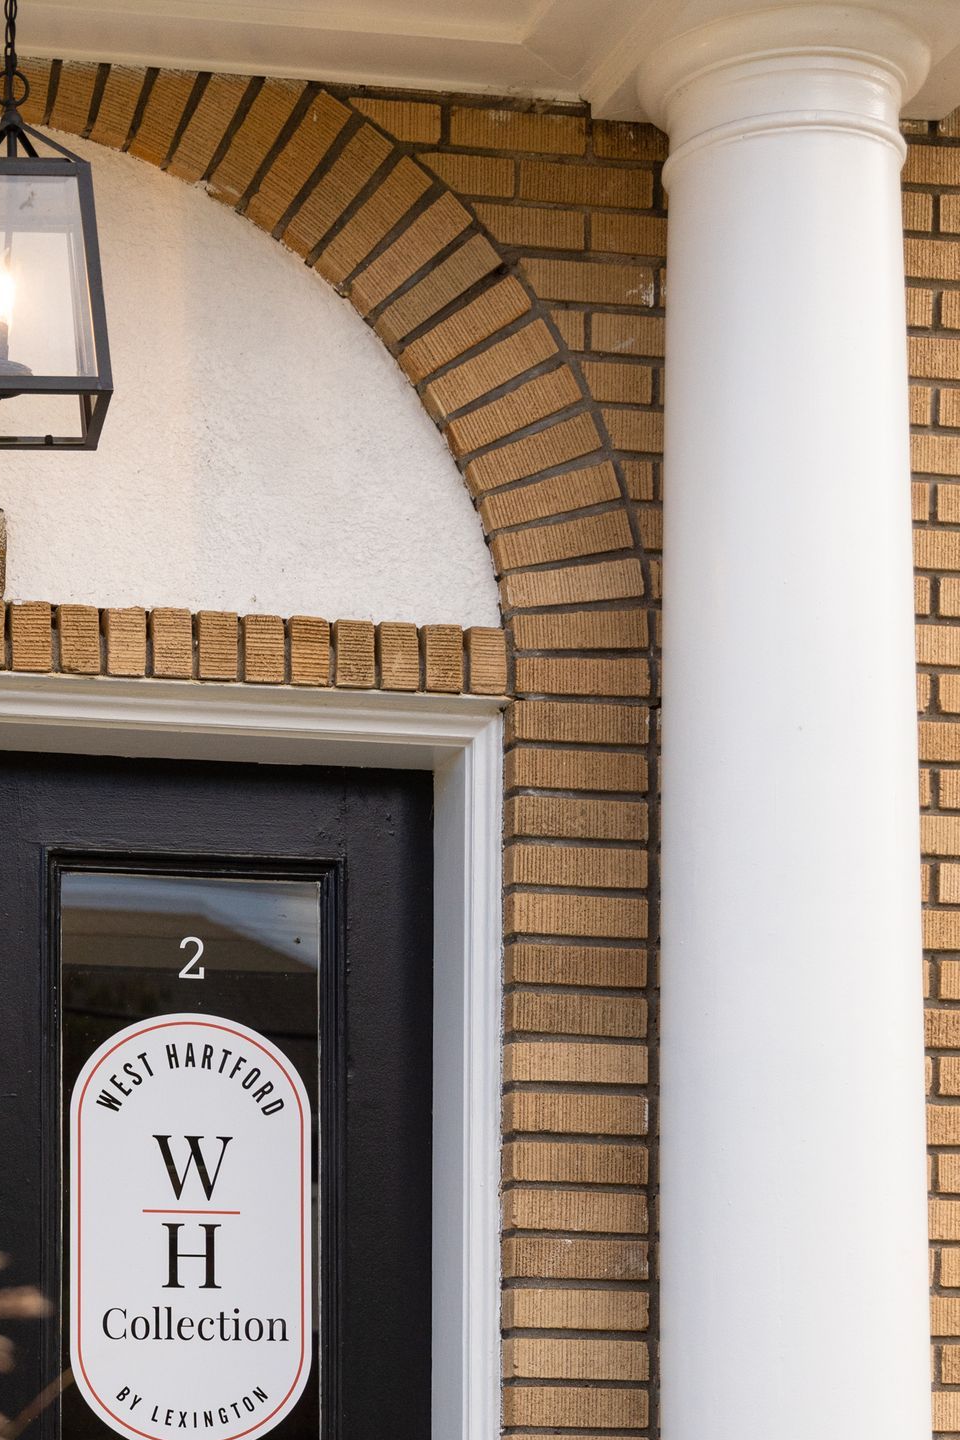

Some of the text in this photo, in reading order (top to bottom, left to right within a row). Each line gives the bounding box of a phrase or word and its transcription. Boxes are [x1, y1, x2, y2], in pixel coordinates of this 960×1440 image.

[178, 936, 205, 980] 2
[95, 1042, 285, 1116] WEST HARTFORD
[151, 1134, 233, 1202] W
[161, 1223, 222, 1289] H
[102, 1306, 290, 1342] Collection
[115, 1385, 269, 1429] BY LEXINGTON
